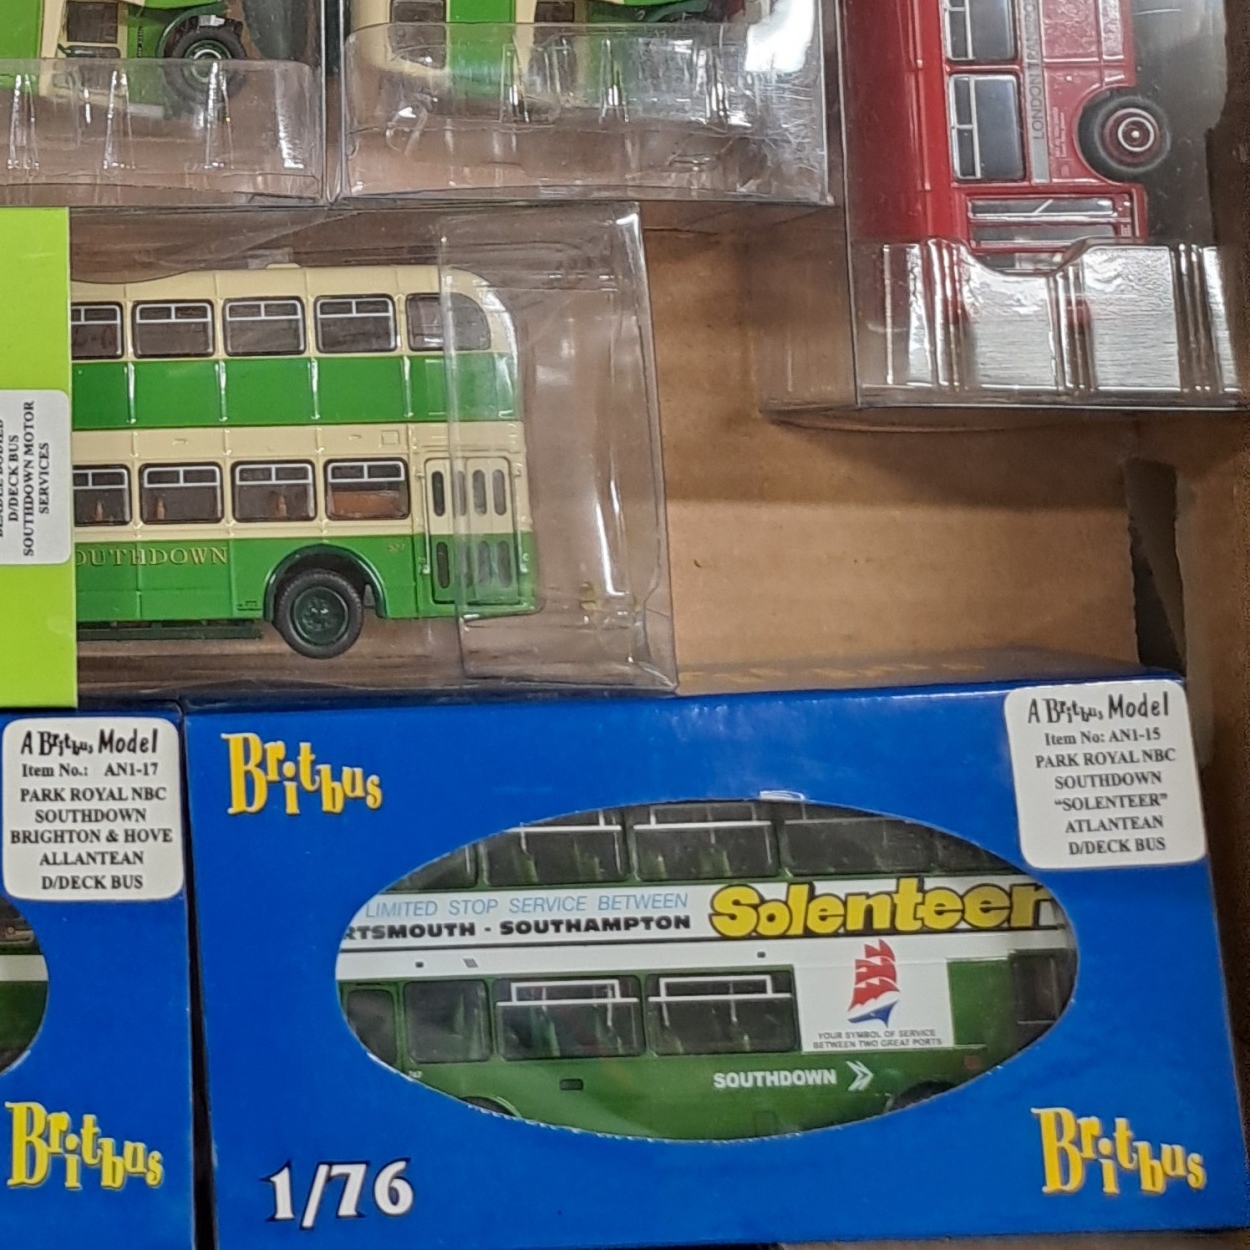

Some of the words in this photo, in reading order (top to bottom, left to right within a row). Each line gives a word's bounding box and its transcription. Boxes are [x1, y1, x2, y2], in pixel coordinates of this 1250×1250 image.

[23, 401, 35, 456] MOTOR
[9, 435, 19, 463] BUS
[39, 442, 50, 514] SERVICES
[8, 467, 19, 522] D/DECK
[23, 459, 34, 556] SOUTHDOWN
[1028, 698, 1040, 724] A
[1042, 698, 1103, 724] Britbus
[1108, 691, 1169, 719] Model
[21, 731, 32, 755] A
[38, 731, 93, 756] Britbus
[99, 728, 158, 754] Model
[1044, 732, 1076, 746] Item
[1080, 730, 1105, 744] No:
[1109, 727, 1161, 743] AN1-15
[1035, 753, 1079, 768] PARK
[1083, 750, 1140, 767] ROYAL
[1142, 748, 1176, 762] NBC
[221, 732, 382, 815] Britbus
[1054, 771, 1162, 790] SOUTHDOWN
[20, 788, 65, 802] PARK
[70, 787, 128, 801] ROYAL
[132, 787, 167, 801] NBC
[35, 808, 146, 823] SOUTHDOWN
[1065, 815, 1164, 833] ATLANTEAN
[10, 829, 100, 844] BRIGHTON
[106, 829, 118, 843] &
[124, 828, 172, 843] HOVE
[1068, 839, 1131, 855] D/DECK
[1135, 837, 1166, 851] BUS
[39, 851, 144, 866] ALLANTEAN
[41, 876, 107, 890] D/DECK
[111, 874, 143, 889] BUS
[364, 900, 438, 918] LIMITED
[449, 899, 498, 916] STOP
[508, 895, 588, 913] SERVICE
[598, 893, 688, 911] BETWEEN
[709, 876, 1052, 938] Solenteer
[344, 922, 476, 941] RTSMOUTH
[499, 914, 691, 936] SOUTHAMPTON
[713, 1068, 837, 1090] SOUTHDOWN
[5, 1101, 163, 1191] Britbus
[1030, 1107, 1207, 1196] Britbus
[260, 1157, 414, 1230] 1/76
